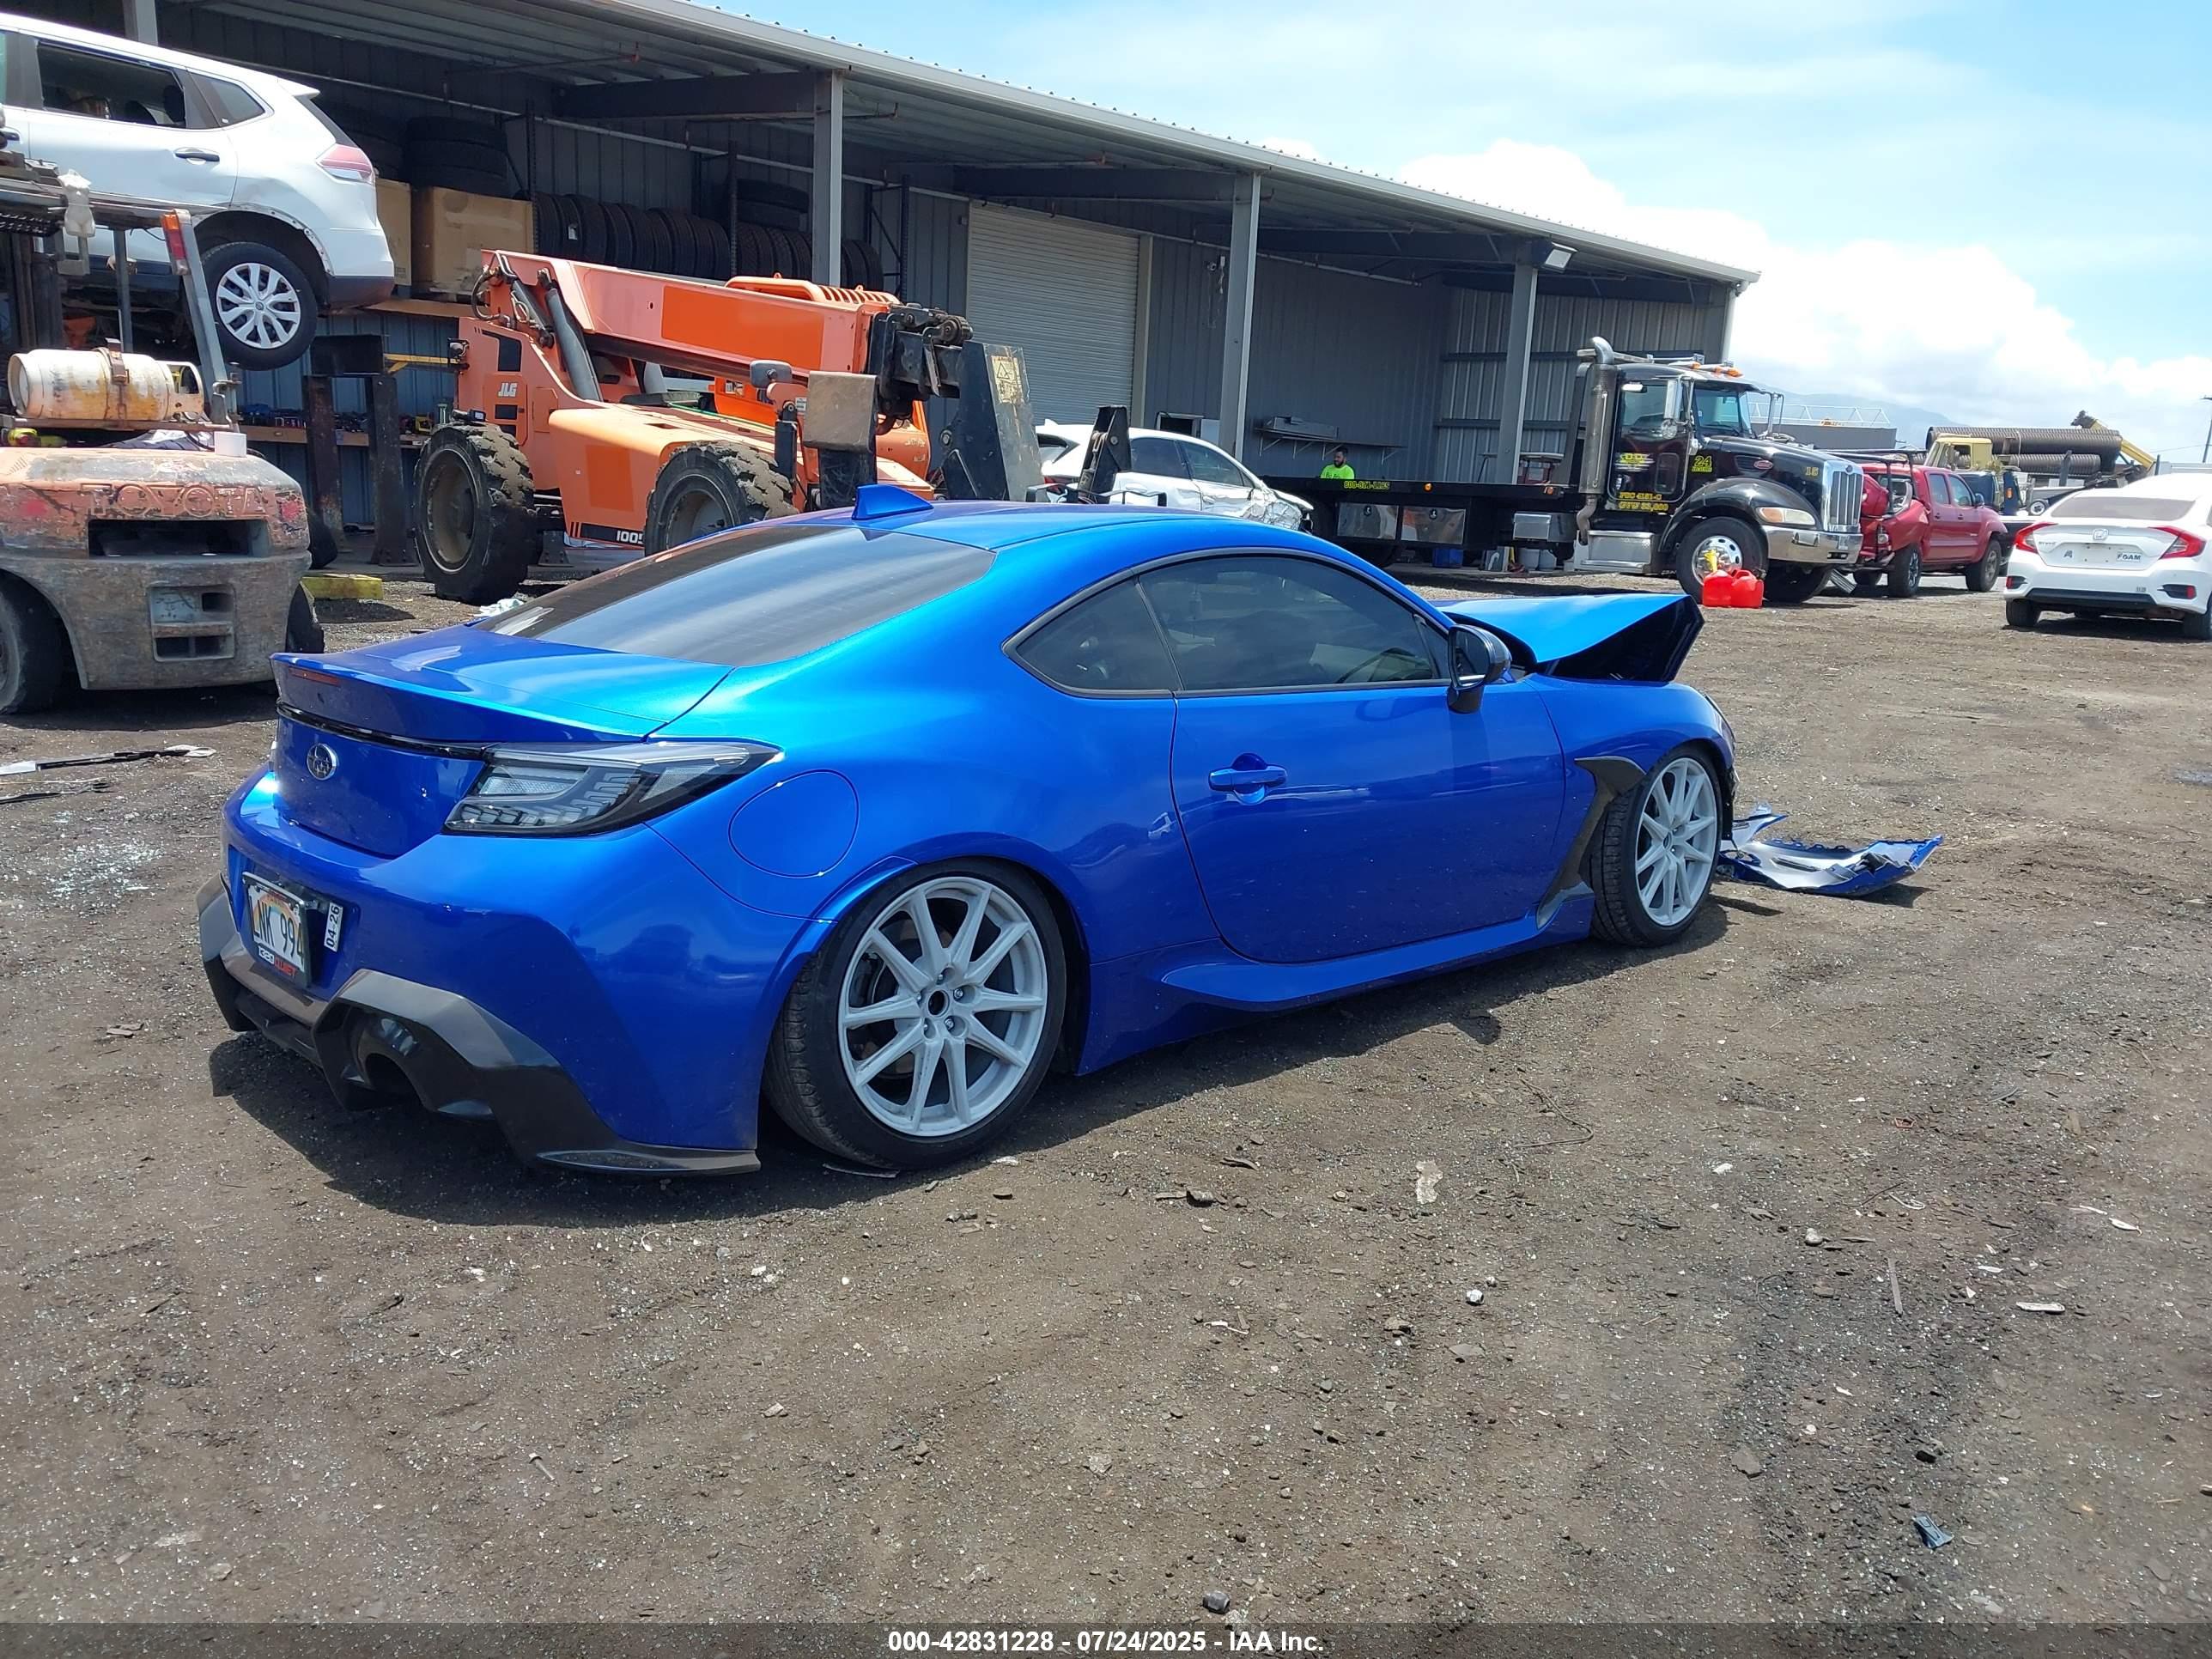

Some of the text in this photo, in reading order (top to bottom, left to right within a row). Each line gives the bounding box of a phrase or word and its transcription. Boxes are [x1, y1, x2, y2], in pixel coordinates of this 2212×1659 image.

[498, 382, 518, 398] JLG
[1694, 455, 1712, 467] 24
[81, 482, 270, 518] TOYOTA
[249, 895, 275, 948] LNK
[281, 912, 304, 968] 994
